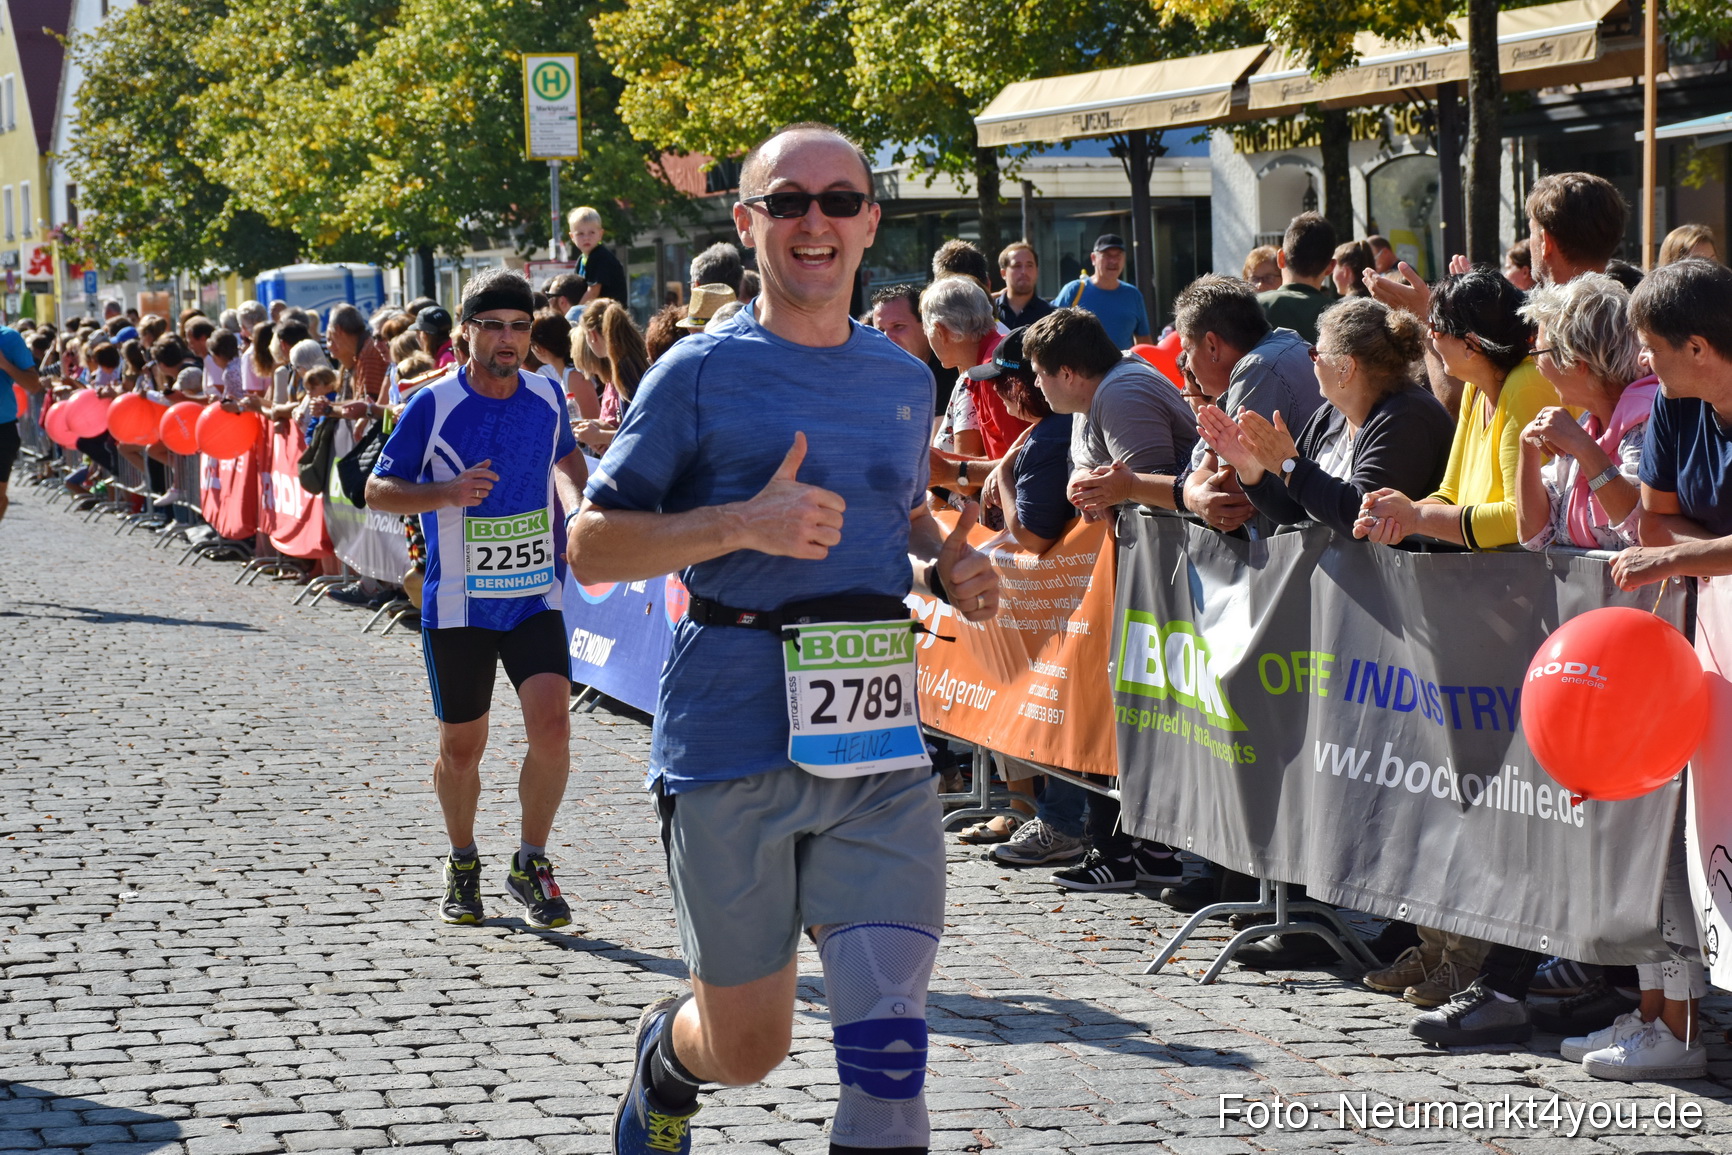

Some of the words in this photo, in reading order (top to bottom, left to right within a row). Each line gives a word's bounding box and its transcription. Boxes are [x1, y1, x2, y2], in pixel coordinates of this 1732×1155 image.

[542, 70, 560, 92] H
[473, 513, 544, 538] BOCK
[477, 539, 545, 570] 2255
[1057, 552, 1097, 569] Partner
[475, 572, 549, 589] BERNHARD
[1043, 574, 1064, 590] und
[1012, 596, 1052, 614] Projekte
[1051, 598, 1070, 610] was
[801, 628, 907, 666] BOCK
[916, 664, 996, 711] tivAgentur
[1344, 658, 1521, 733] INDUSTRY
[1561, 676, 1605, 690] energie
[809, 674, 902, 725] 2789
[1113, 698, 1178, 734] inspired
[1181, 714, 1191, 744] by
